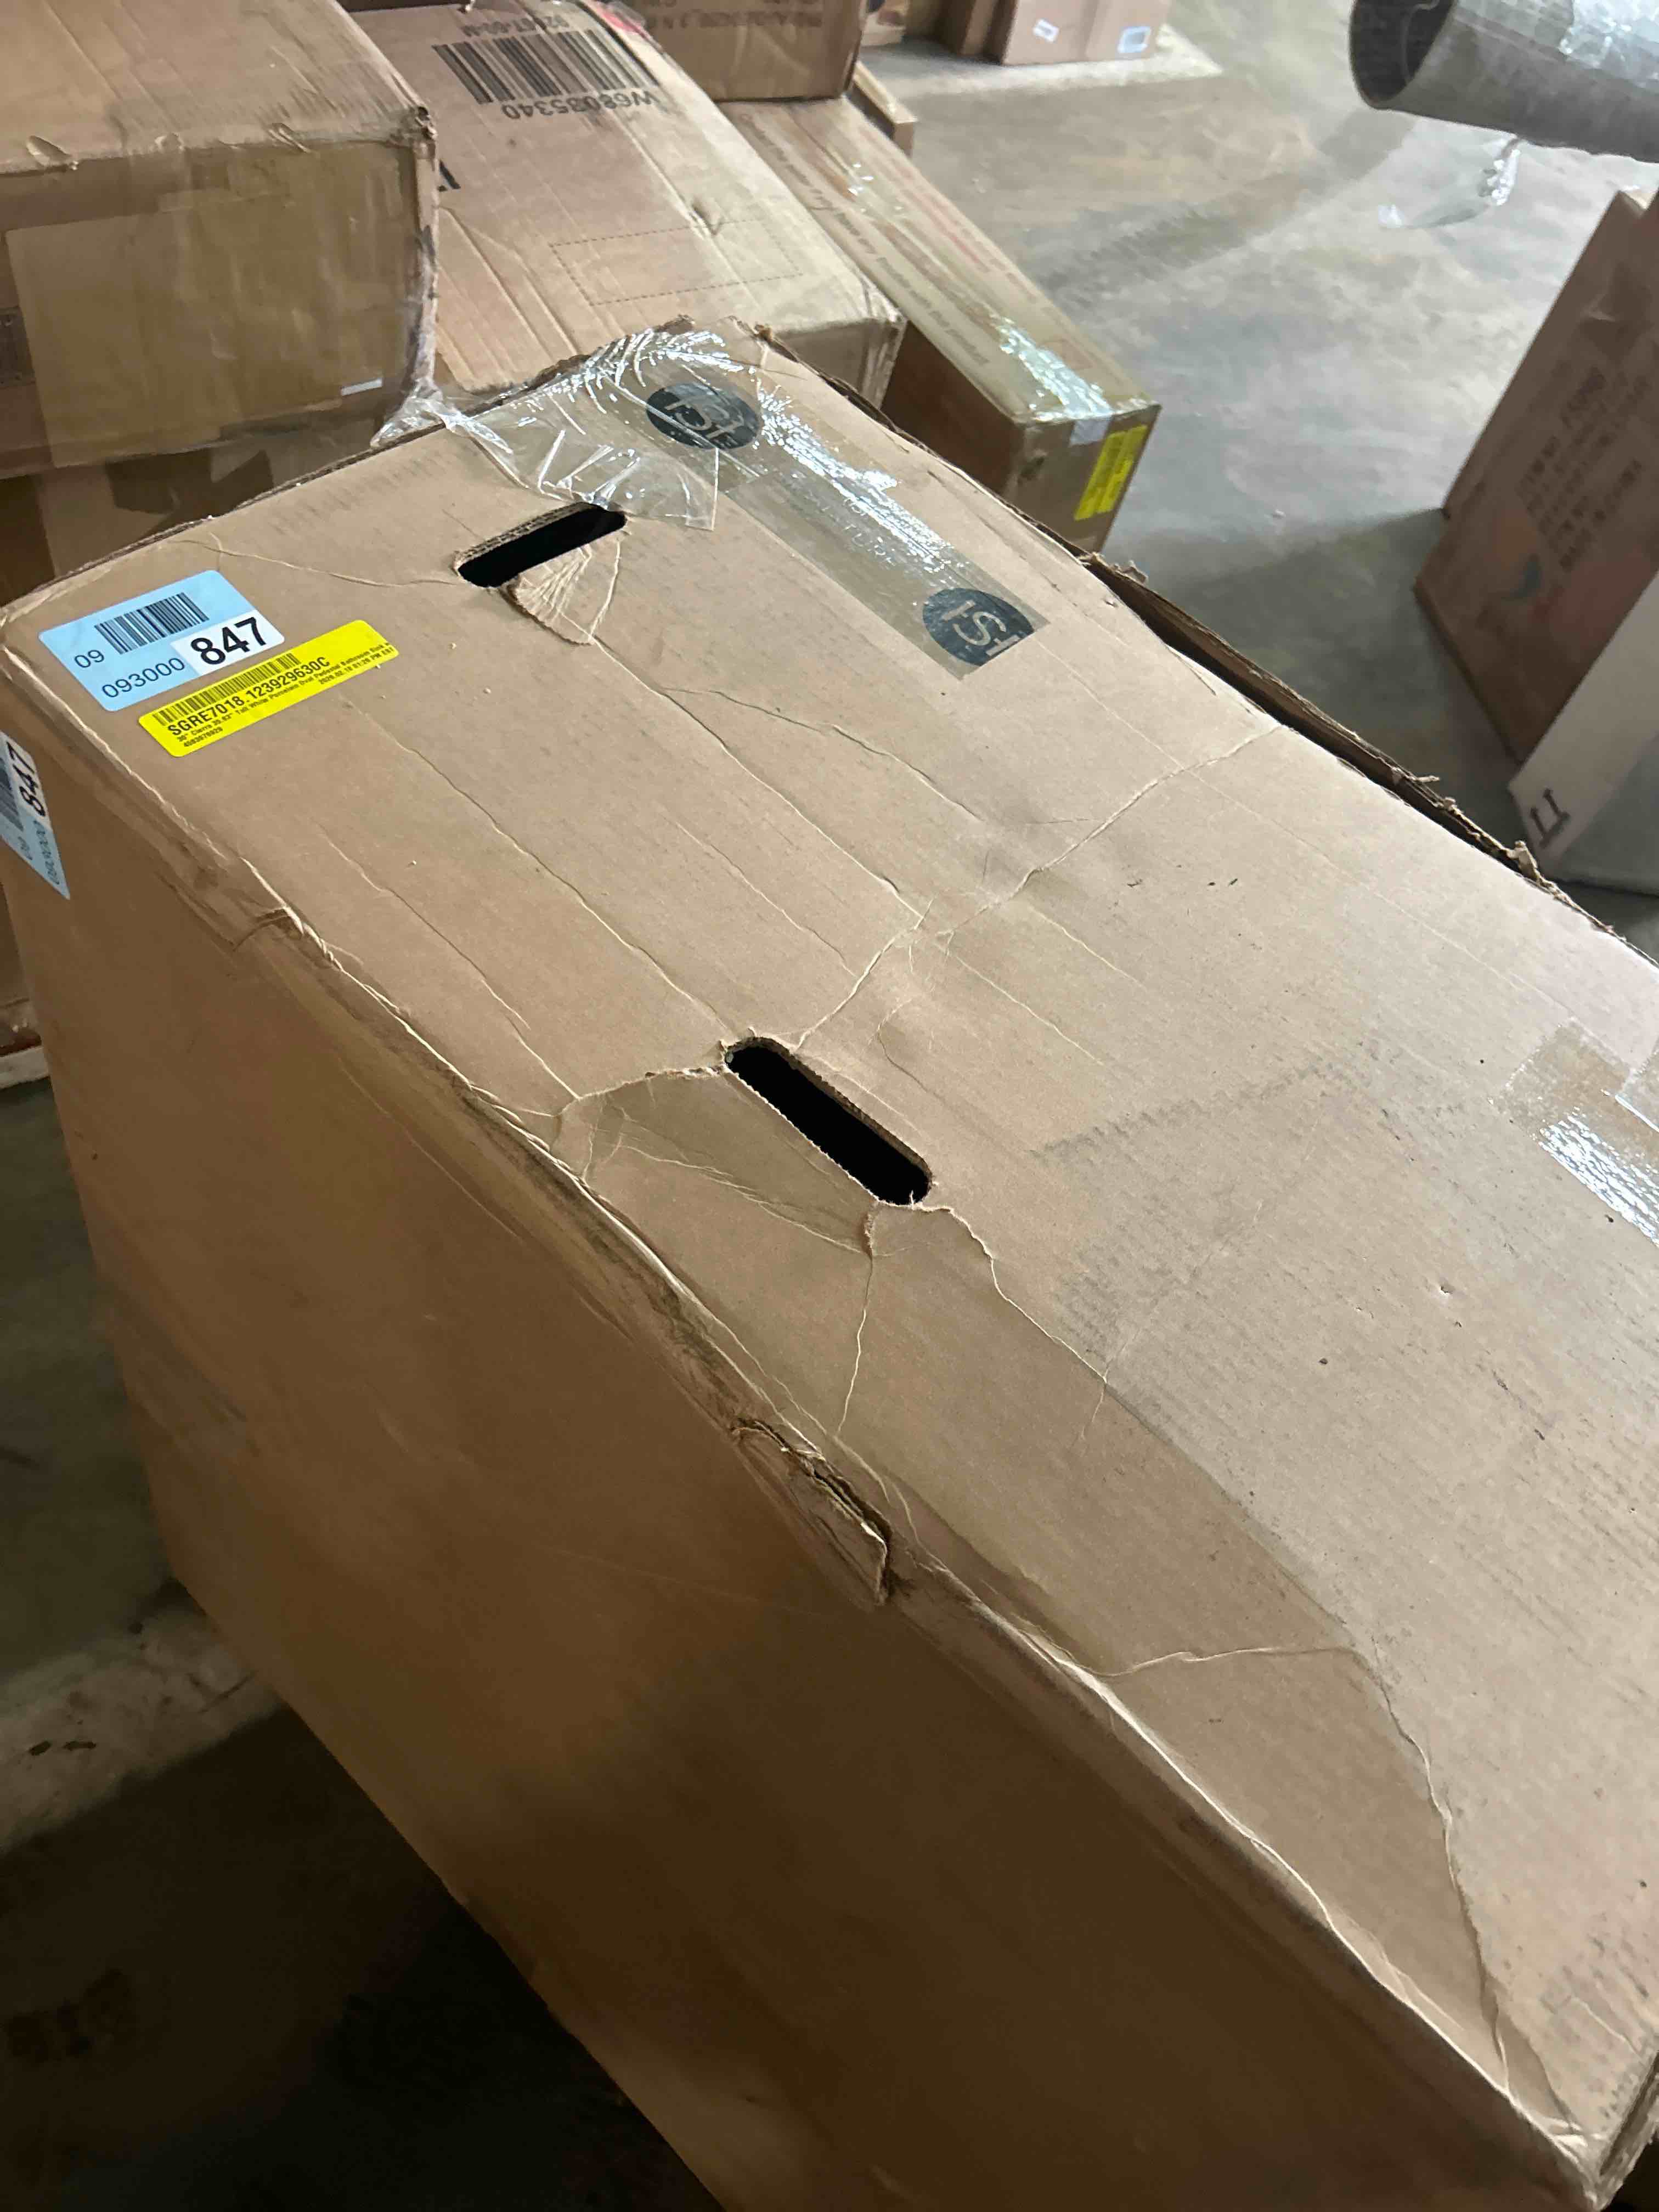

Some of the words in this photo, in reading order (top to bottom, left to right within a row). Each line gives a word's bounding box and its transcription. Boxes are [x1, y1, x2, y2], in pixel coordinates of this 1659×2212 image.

[74, 650, 104, 668] 09
[102, 658, 185, 698] 093000
[190, 616, 266, 665] 847
[167, 657, 330, 736] SGRE7018.123929630C
[7, 741, 46, 817] 847
